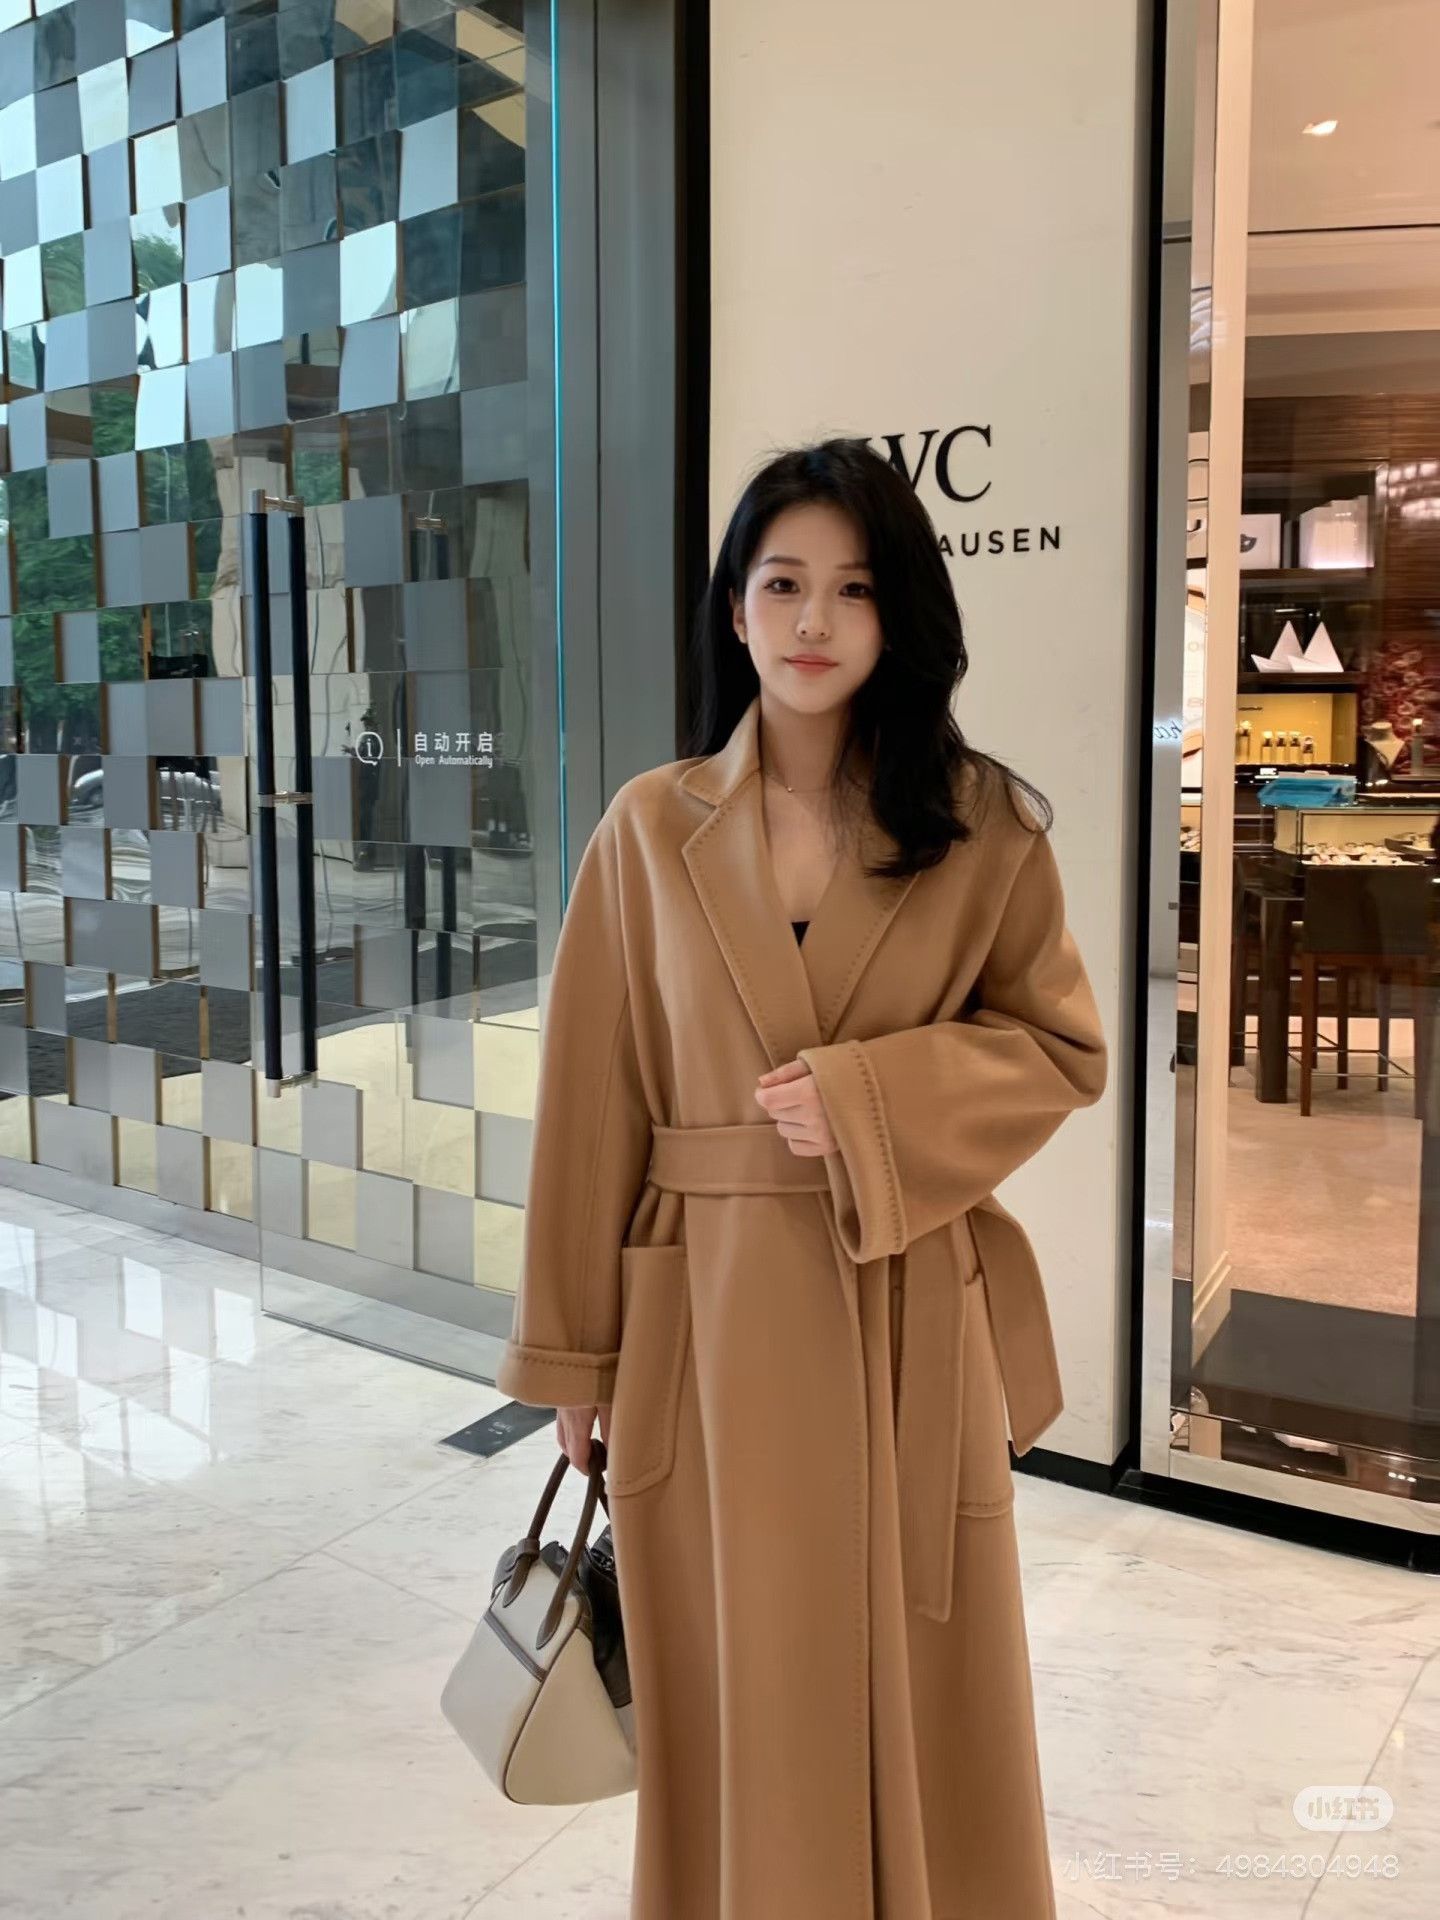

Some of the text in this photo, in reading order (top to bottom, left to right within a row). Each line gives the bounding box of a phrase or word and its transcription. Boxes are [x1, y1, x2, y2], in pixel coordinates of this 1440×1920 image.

[414, 731, 493, 753] 自动开启
[415, 754, 493, 768] Open Automatically
